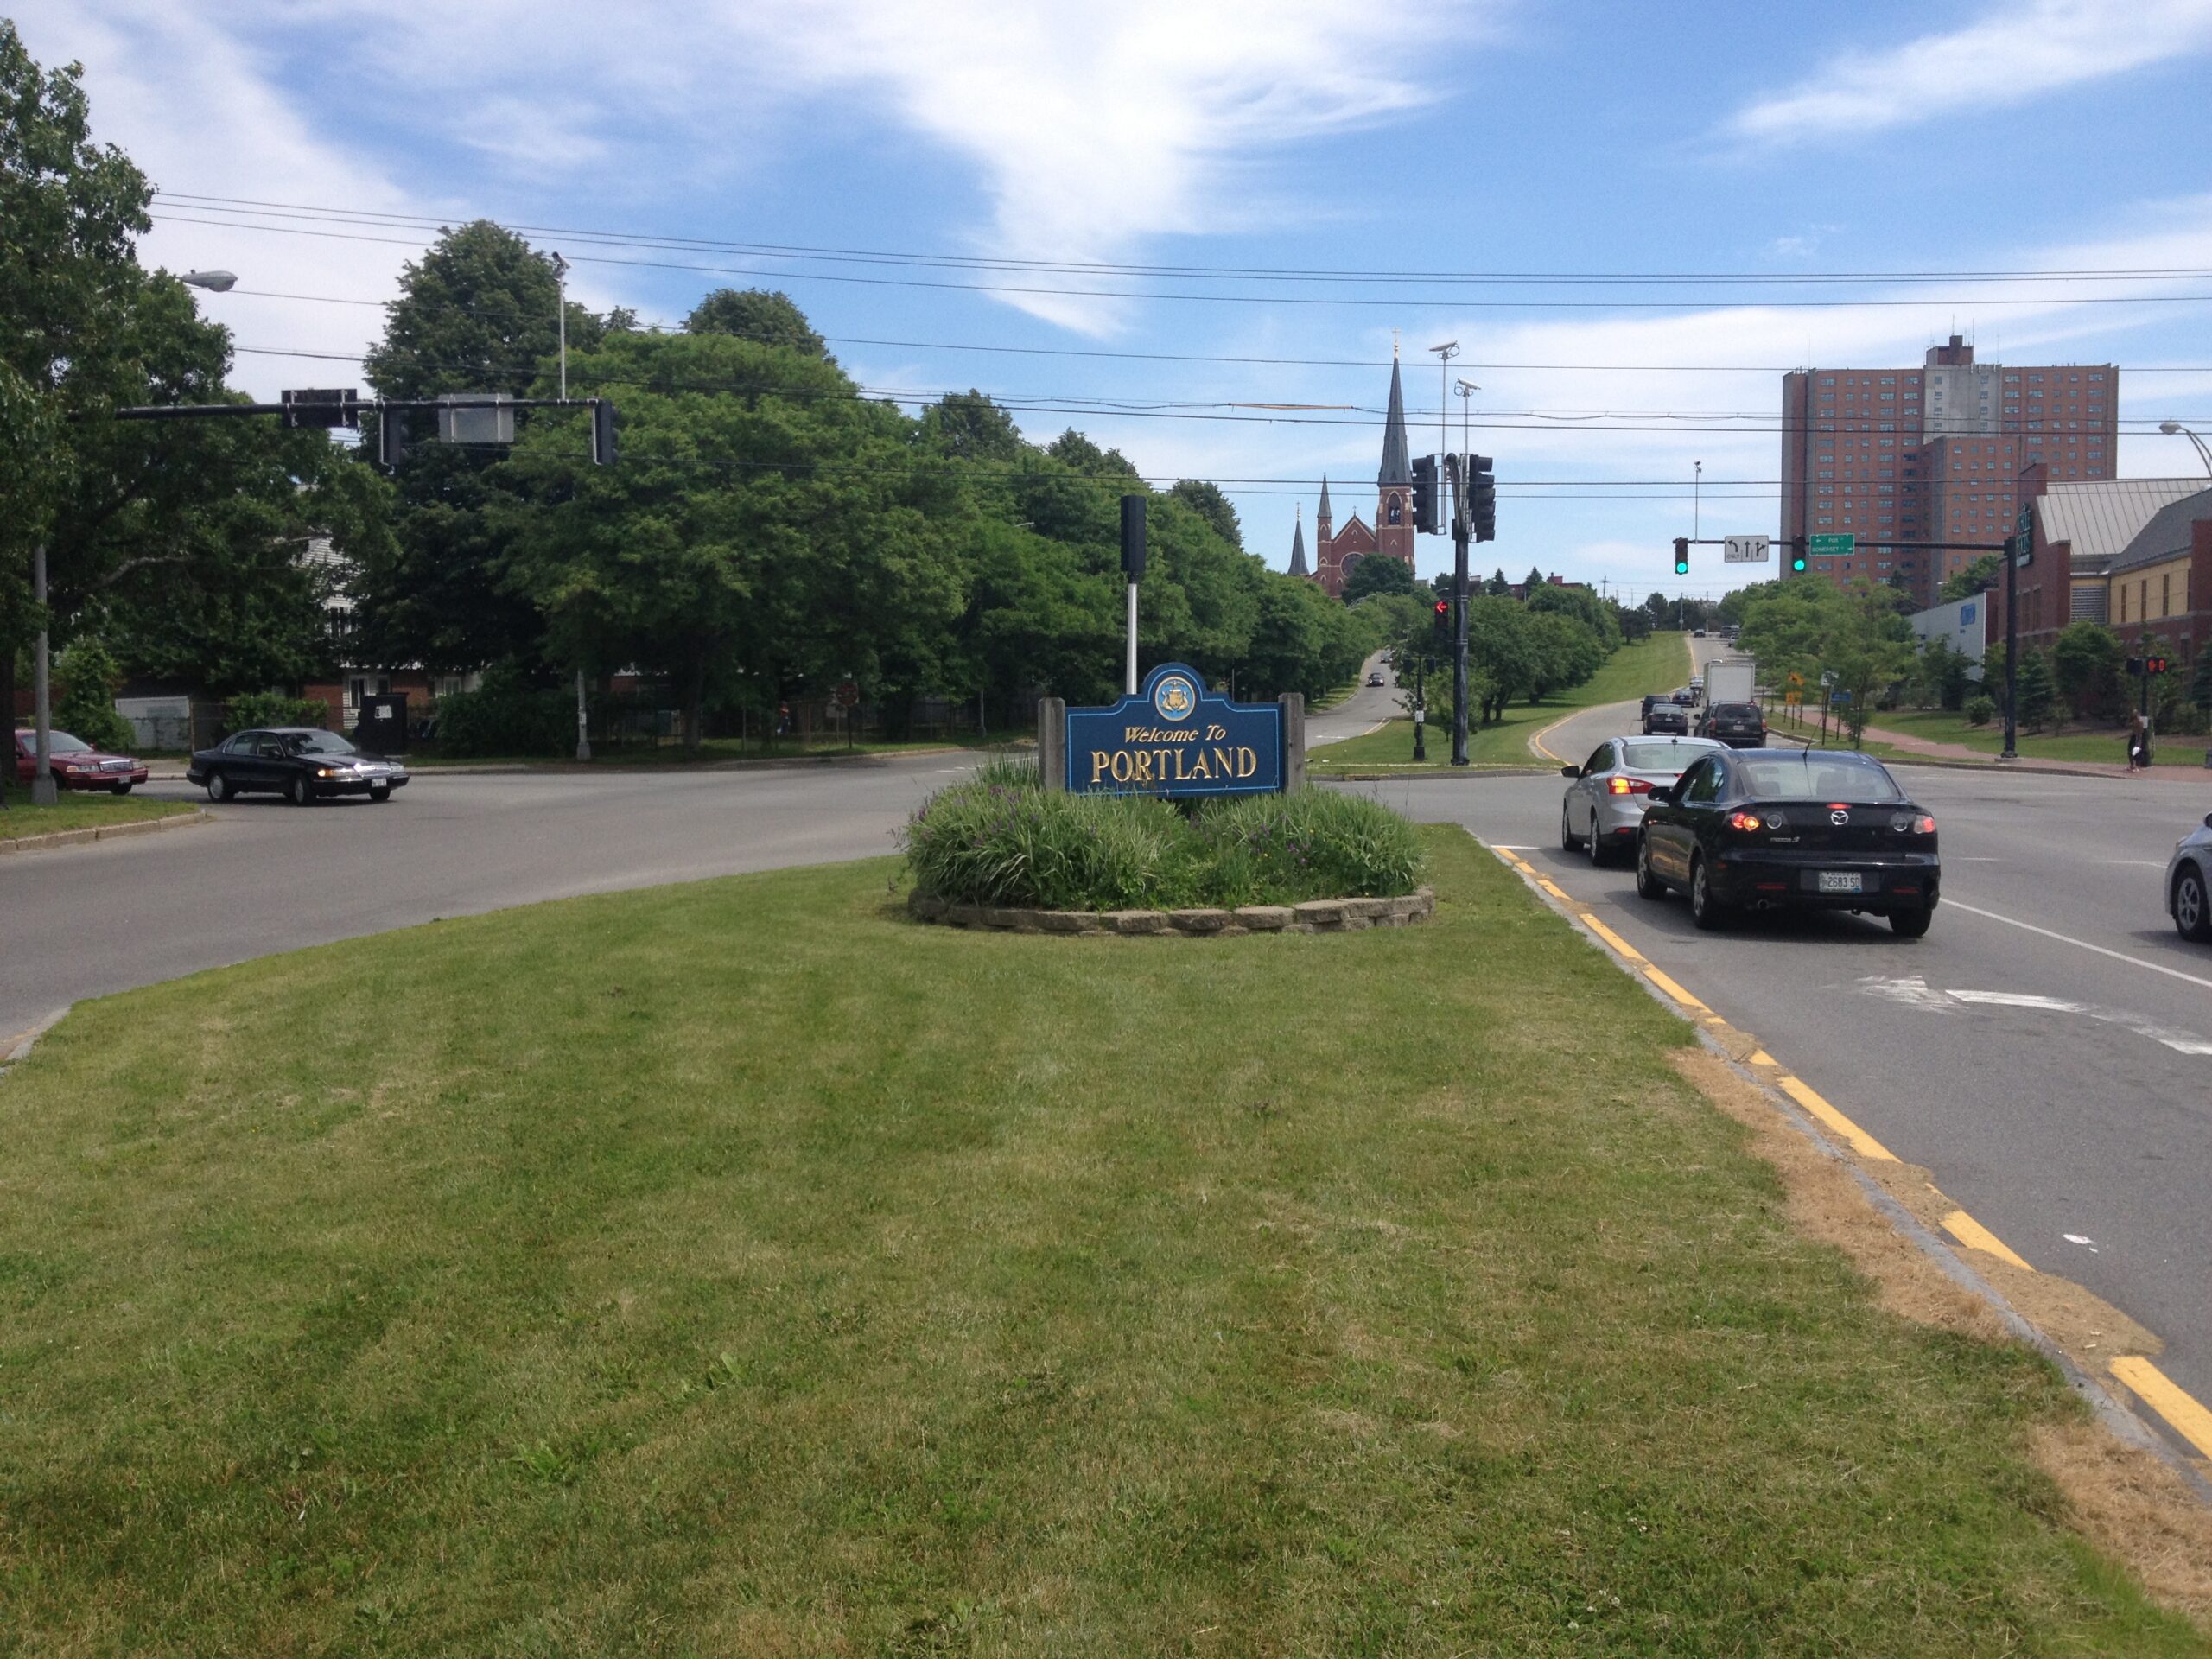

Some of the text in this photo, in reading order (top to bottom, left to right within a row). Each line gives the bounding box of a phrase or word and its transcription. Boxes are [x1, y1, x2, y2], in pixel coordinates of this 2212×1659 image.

[1125, 725, 1226, 743] Welcome To
[1090, 747, 1257, 783] PORTLAND
[1827, 876, 1848, 887] 2683
